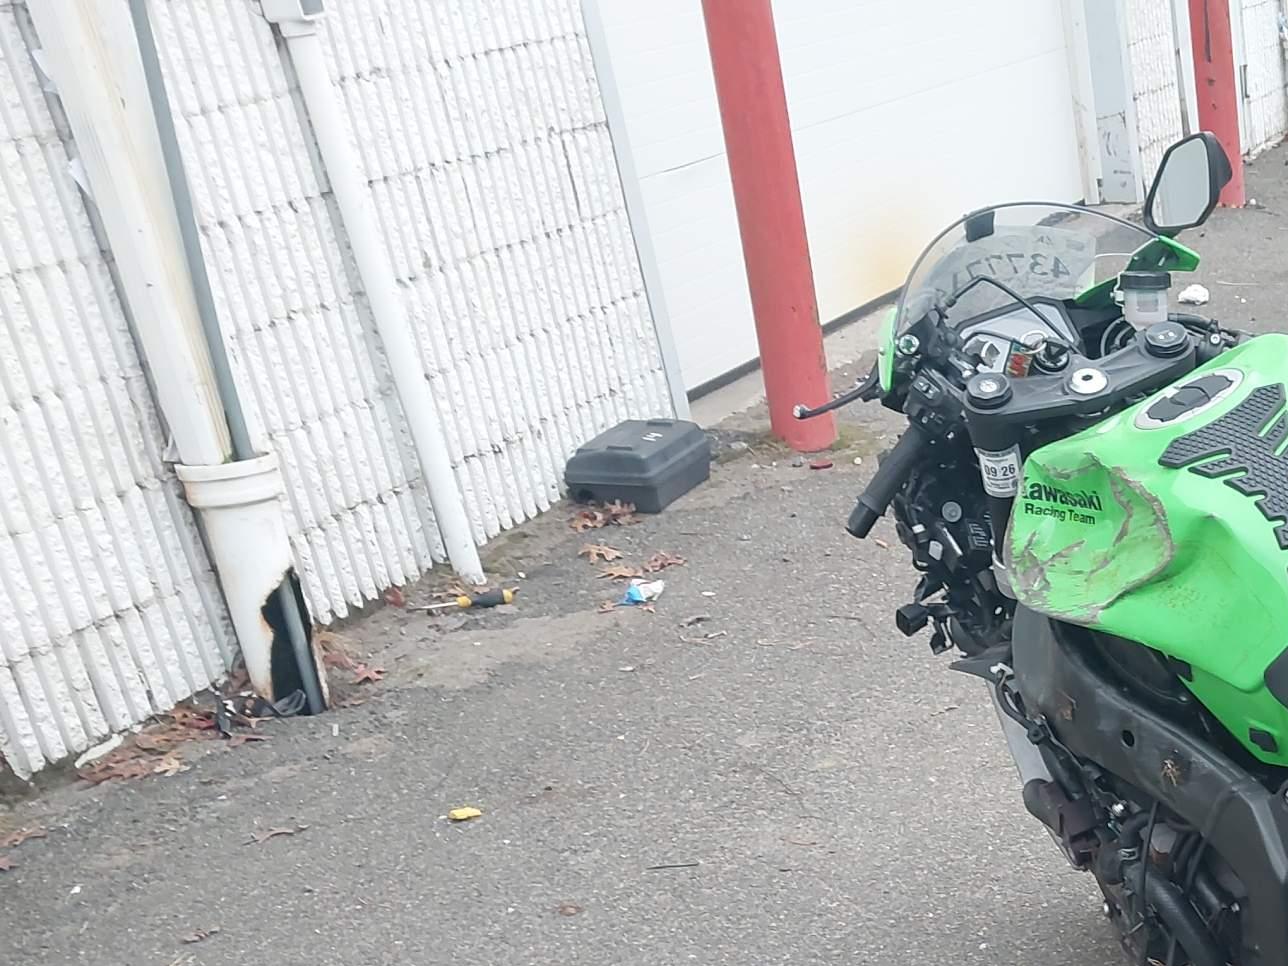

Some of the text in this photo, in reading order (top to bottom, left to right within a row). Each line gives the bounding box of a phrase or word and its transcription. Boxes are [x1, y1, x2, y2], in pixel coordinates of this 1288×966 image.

[984, 463, 1016, 477] 09 26
[1024, 502, 1096, 525] Racing Team
